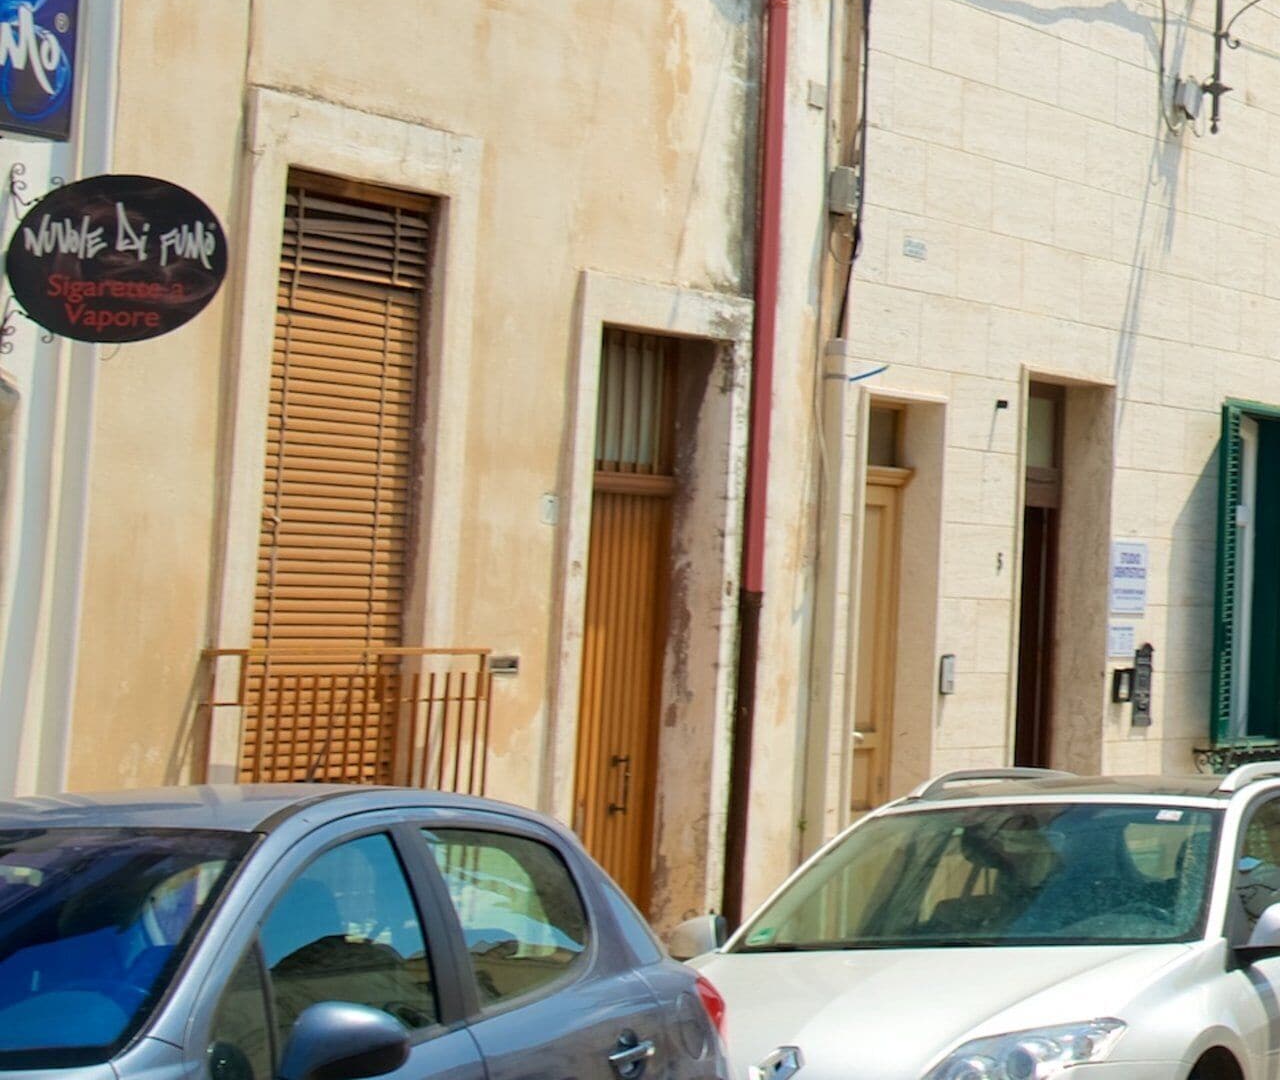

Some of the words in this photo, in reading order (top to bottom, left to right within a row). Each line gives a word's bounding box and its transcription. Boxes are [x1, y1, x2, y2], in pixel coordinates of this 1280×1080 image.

[47, 273, 163, 302] Sigarette
[171, 281, 186, 299] a
[64, 302, 161, 332] Vapore
